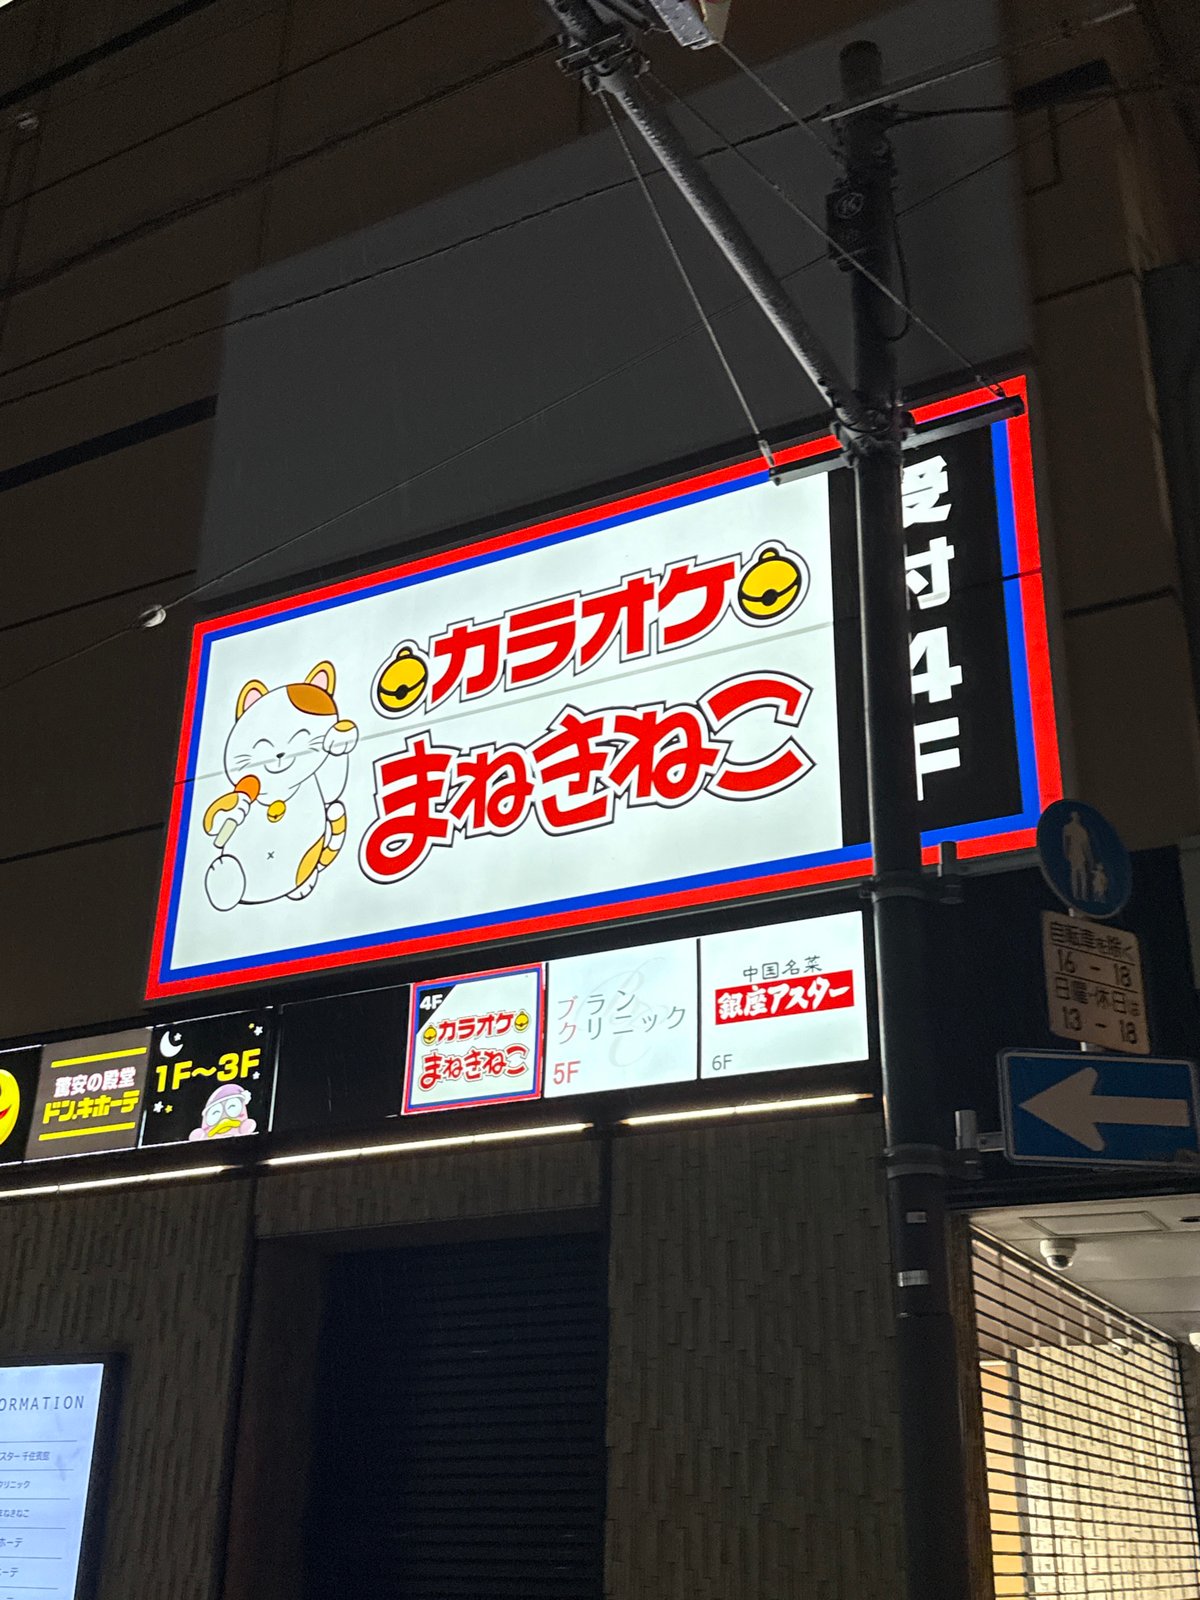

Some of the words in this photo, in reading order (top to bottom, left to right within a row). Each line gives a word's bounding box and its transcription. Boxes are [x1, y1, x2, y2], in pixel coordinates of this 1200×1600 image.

[429, 559, 737, 706] カラオケ
[362, 675, 808, 879] まねきねこ
[742, 954, 823, 982] 中国名菜
[419, 993, 444, 1011] 4F
[557, 989, 636, 1021] ブラン
[717, 976, 851, 1020] 銀座アスター
[437, 1012, 515, 1042] カラオケ
[558, 1005, 686, 1045] クリニック
[419, 1044, 528, 1090] まねきねこ
[552, 1060, 581, 1085] 5F
[711, 1054, 733, 1071] 6F
[0, 1567, 19, 1578] ーテ
